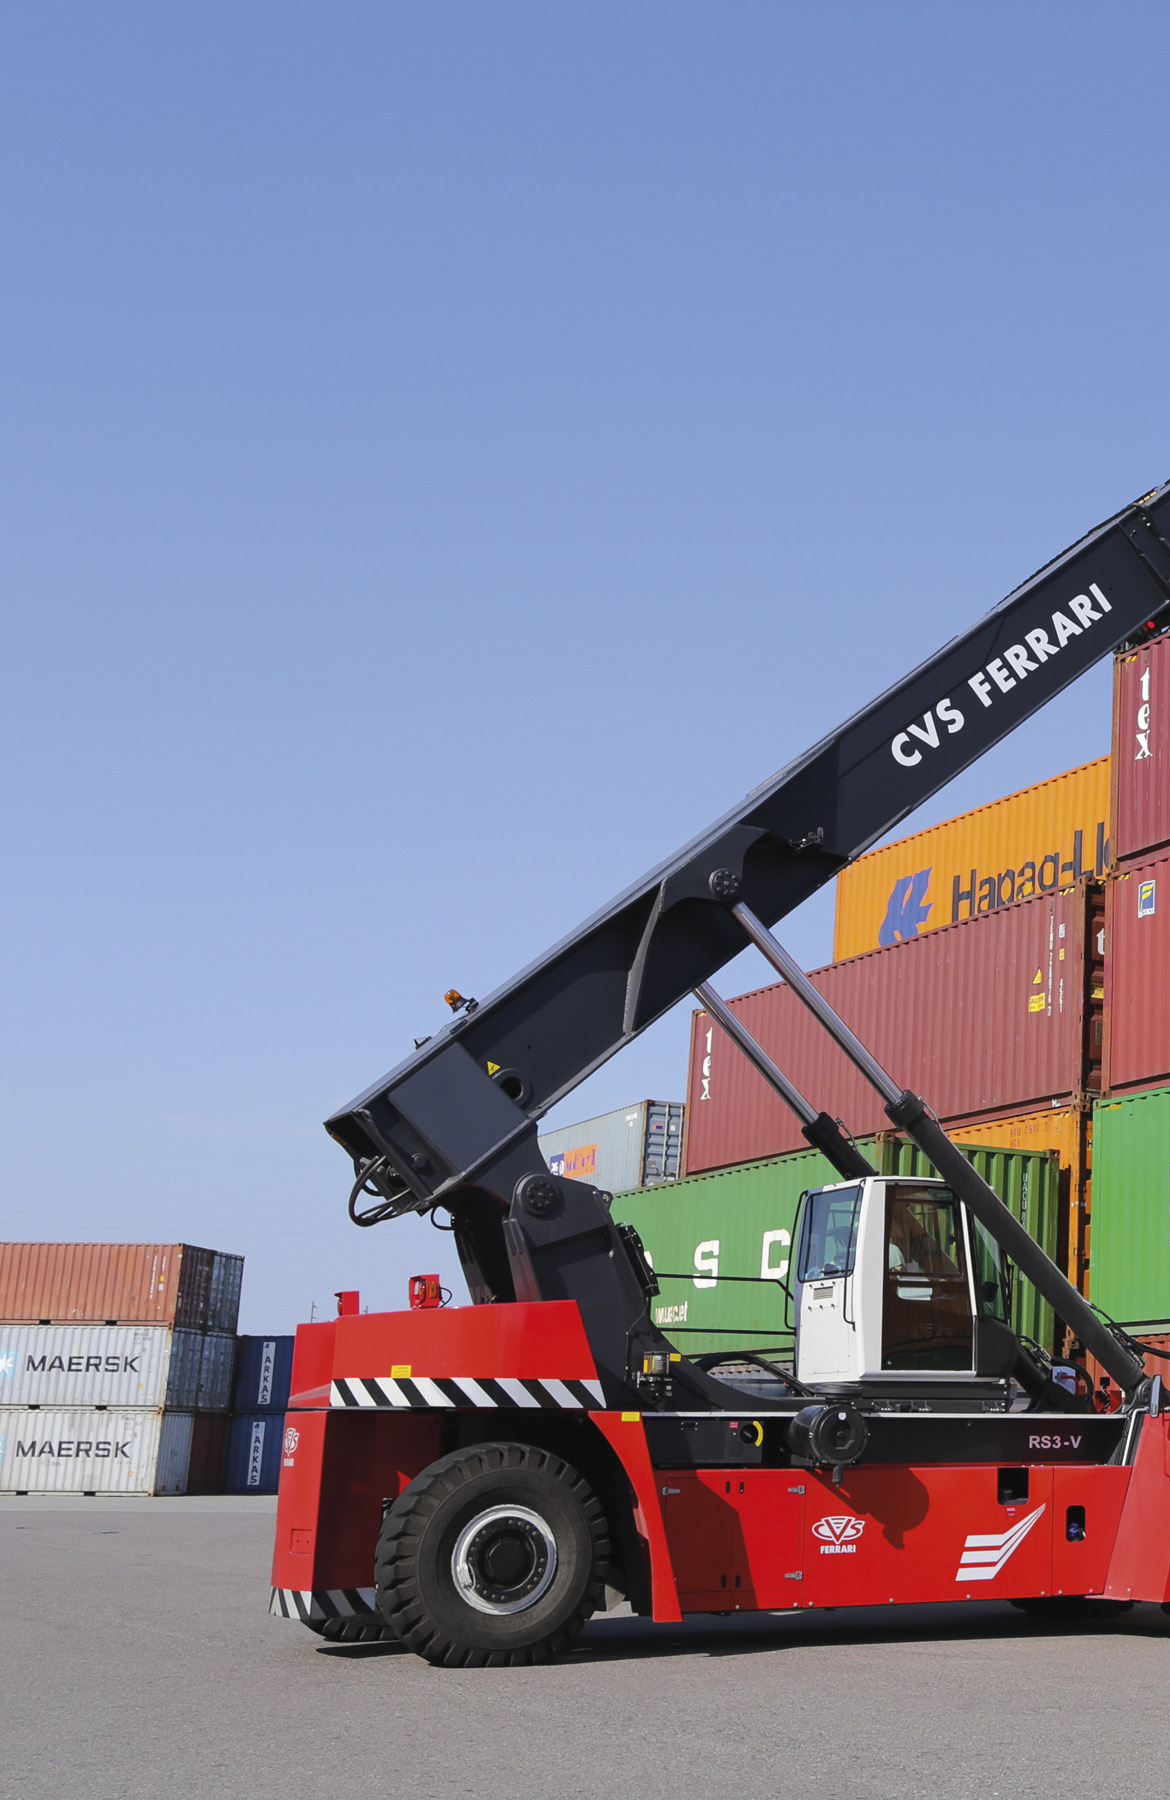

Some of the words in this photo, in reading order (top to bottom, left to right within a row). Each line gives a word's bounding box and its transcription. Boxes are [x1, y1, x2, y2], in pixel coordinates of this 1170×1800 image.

[890, 697, 965, 767] CVS
[967, 582, 1113, 708] FERRARI
[1134, 666, 1153, 761] tex
[26, 1355, 140, 1373] MAERSK
[260, 1355, 272, 1404] ARKAS
[15, 1440, 132, 1458] MAERSK
[1028, 1435, 1082, 1449] RS3-V
[250, 1435, 262, 1484] ARKAS
[811, 1515, 866, 1545] CVS
[820, 1544, 857, 1555] FERRARI
